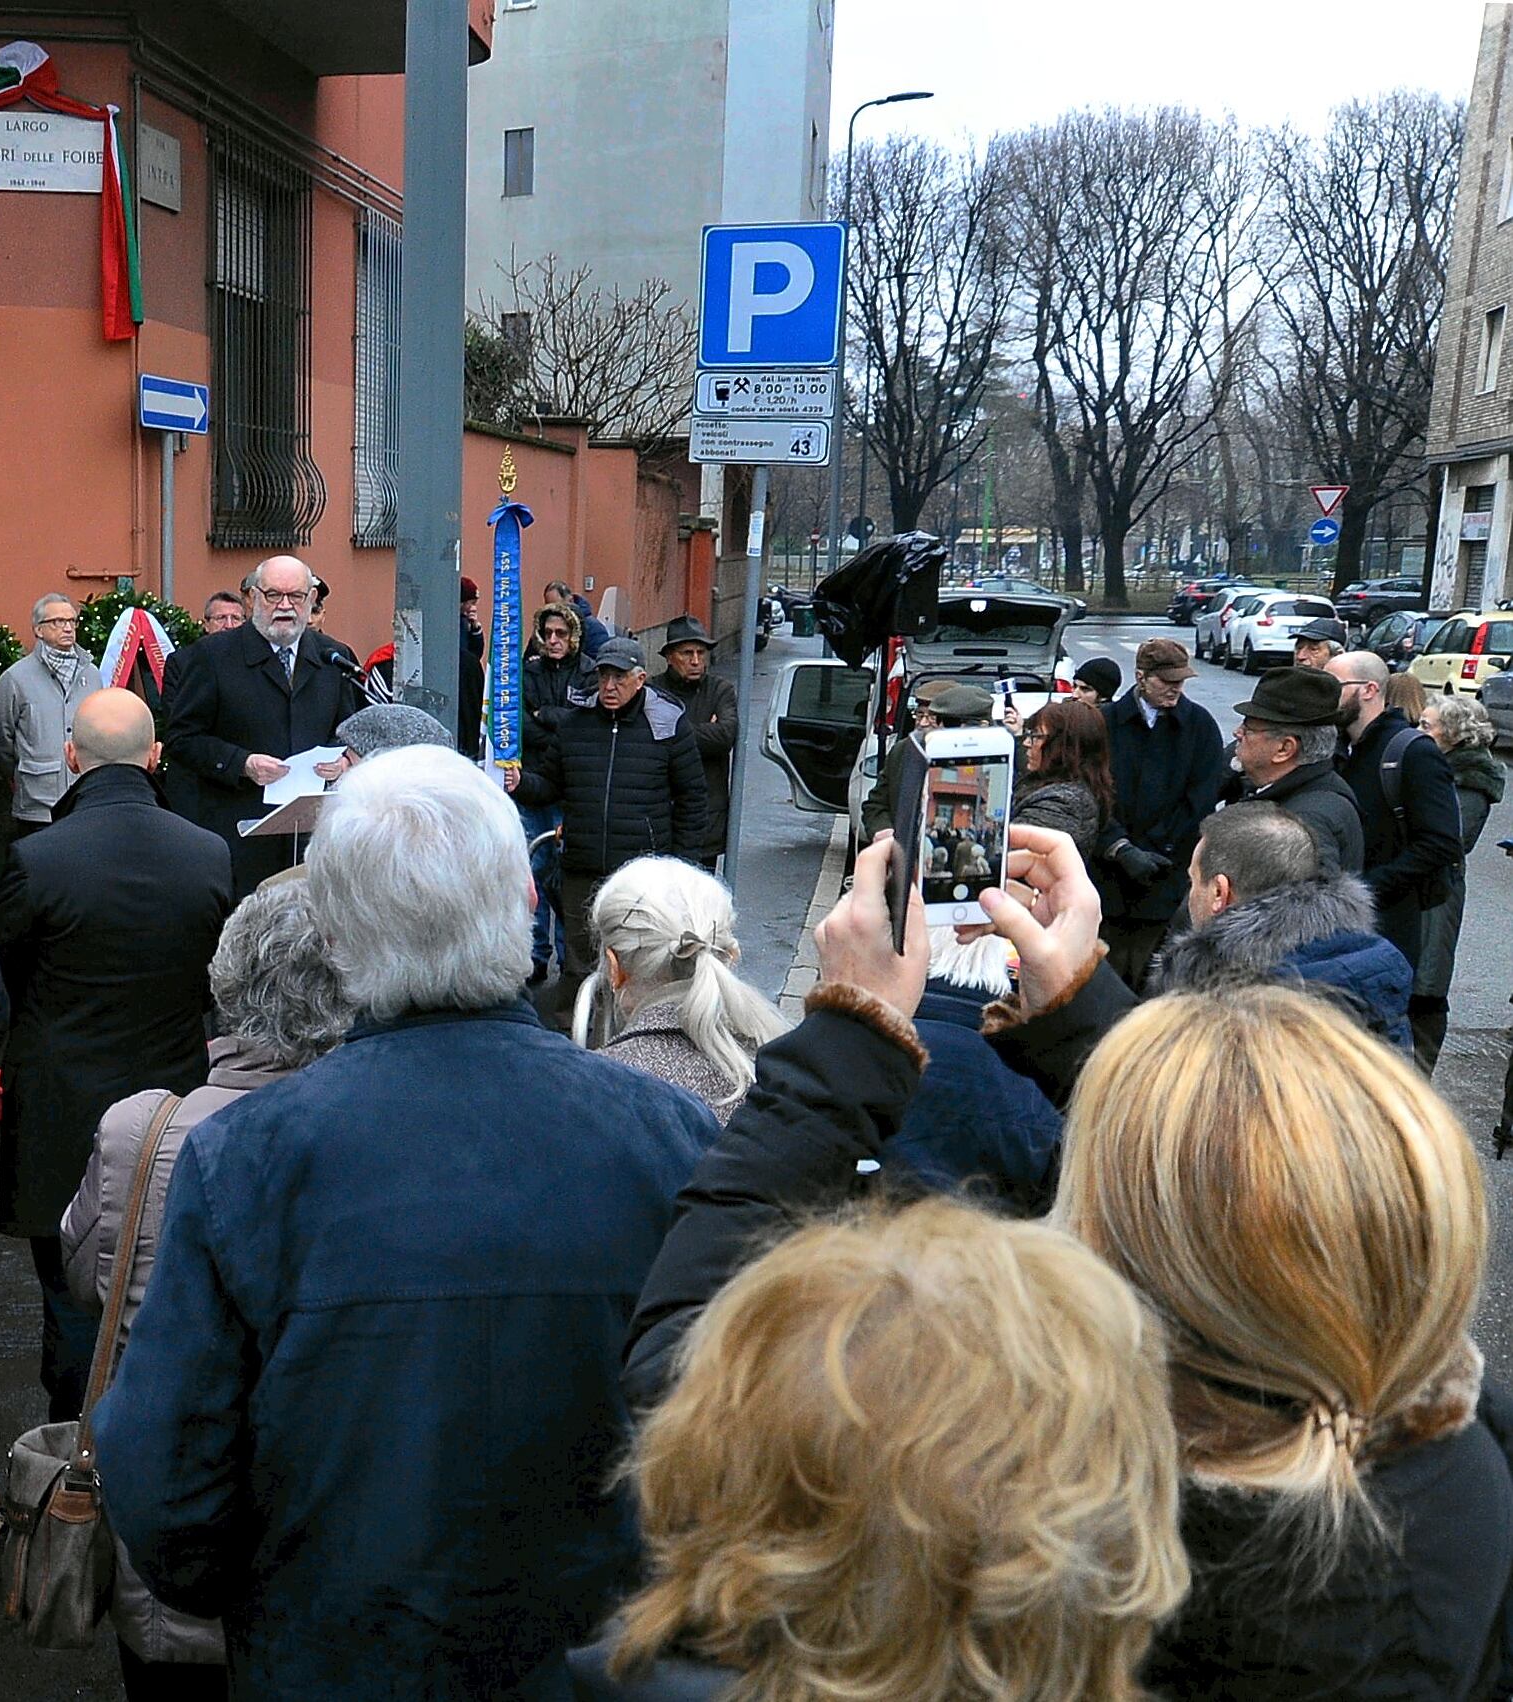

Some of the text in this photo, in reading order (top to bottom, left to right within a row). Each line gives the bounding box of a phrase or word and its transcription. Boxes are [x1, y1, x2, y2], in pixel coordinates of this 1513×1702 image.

[6, 121, 49, 132] LARGO
[23, 152, 55, 163] DELLE
[63, 150, 103, 164] FOIBE
[727, 241, 815, 353] P
[761, 375, 775, 383] dal
[778, 375, 791, 383] lun
[795, 375, 804, 383] al
[718, 439, 774, 448] contrassegno
[790, 440, 811, 456] 43
[699, 449, 736, 457] abbonati
[500, 711, 510, 749] LAVORO
